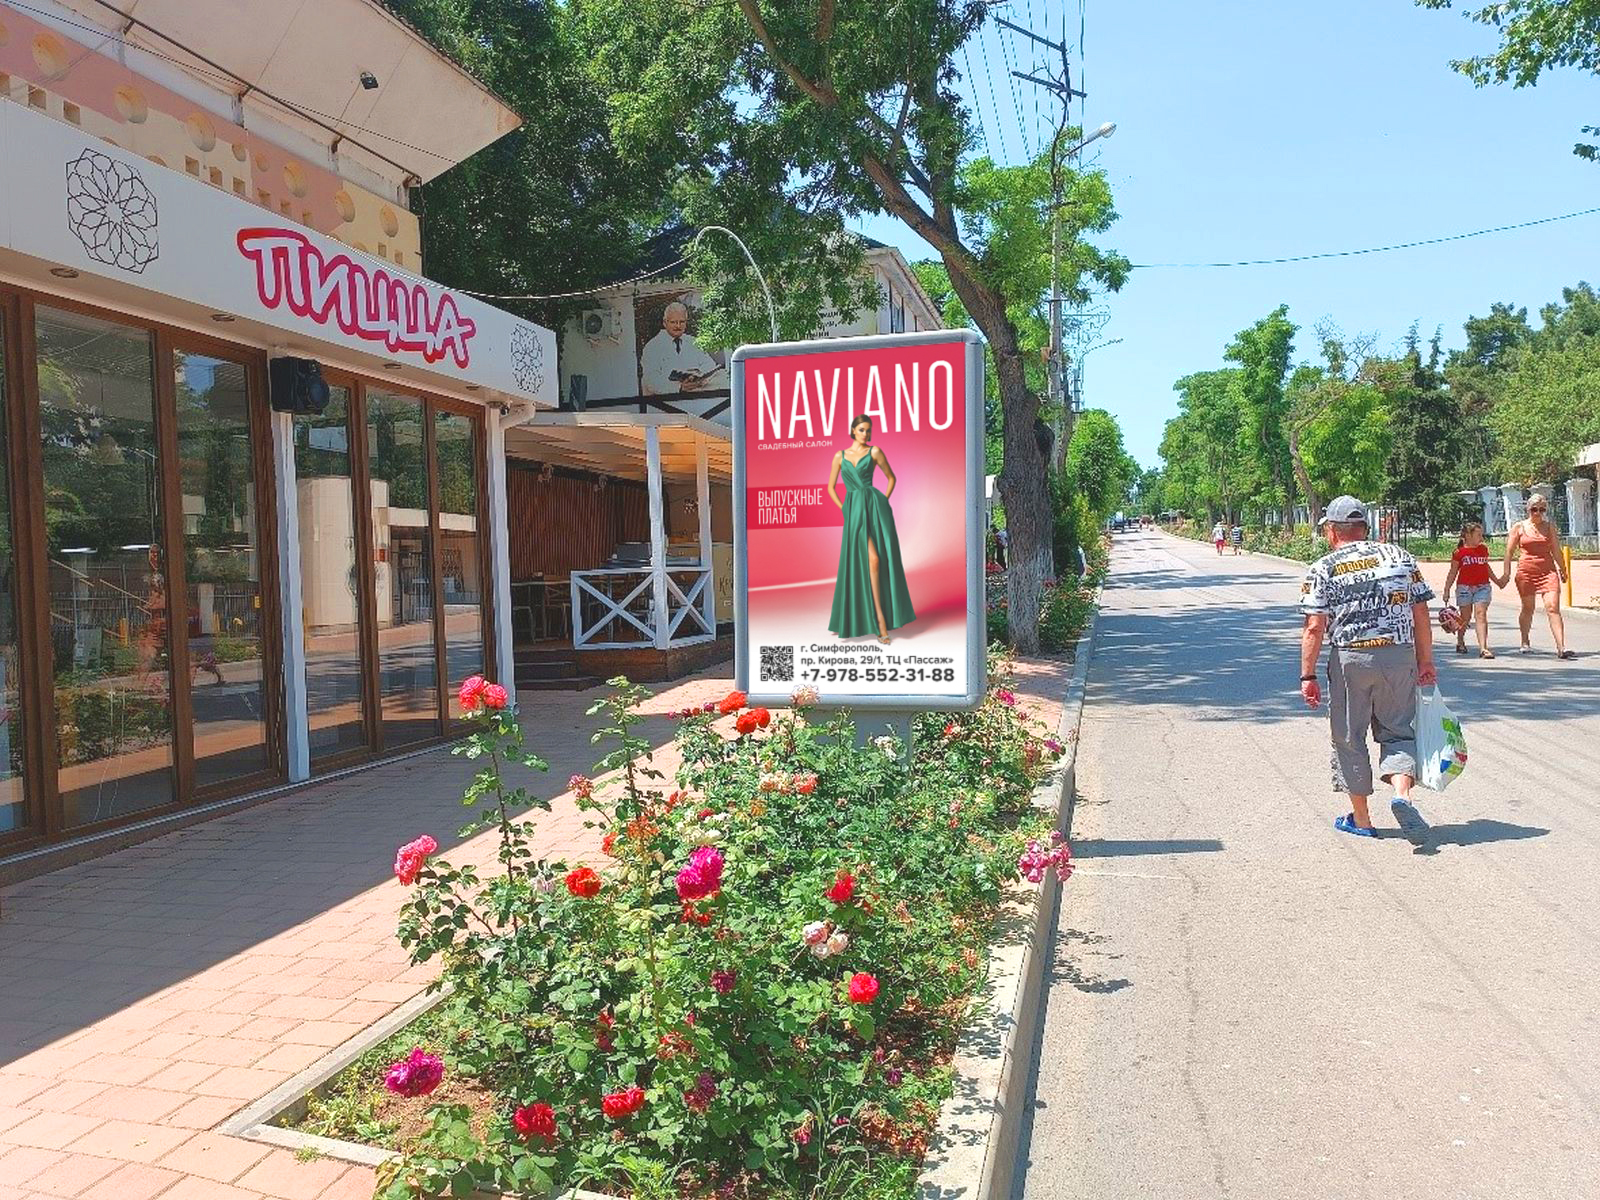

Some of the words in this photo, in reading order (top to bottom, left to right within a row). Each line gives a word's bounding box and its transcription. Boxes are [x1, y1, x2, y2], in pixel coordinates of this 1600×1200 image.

[237, 228, 476, 369] ПИЦЦА
[758, 360, 953, 440] NAVIANO
[758, 441, 804, 450] СВАДЕБНЫЙ
[805, 440, 833, 448] САЛОН
[758, 488, 823, 507] ВЫПУСКНЫЕ
[758, 507, 797, 525] ПЛАТЬЯ
[800, 645, 809, 653] г.
[810, 644, 883, 653] Симферополь,
[801, 657, 817, 666] пр.
[818, 656, 858, 666] Кирова,
[860, 656, 884, 666] 29/1,
[886, 656, 901, 666] ТЦ
[903, 656, 954, 665] «Пассаж»
[801, 668, 955, 682] +7-978-552-31-88
